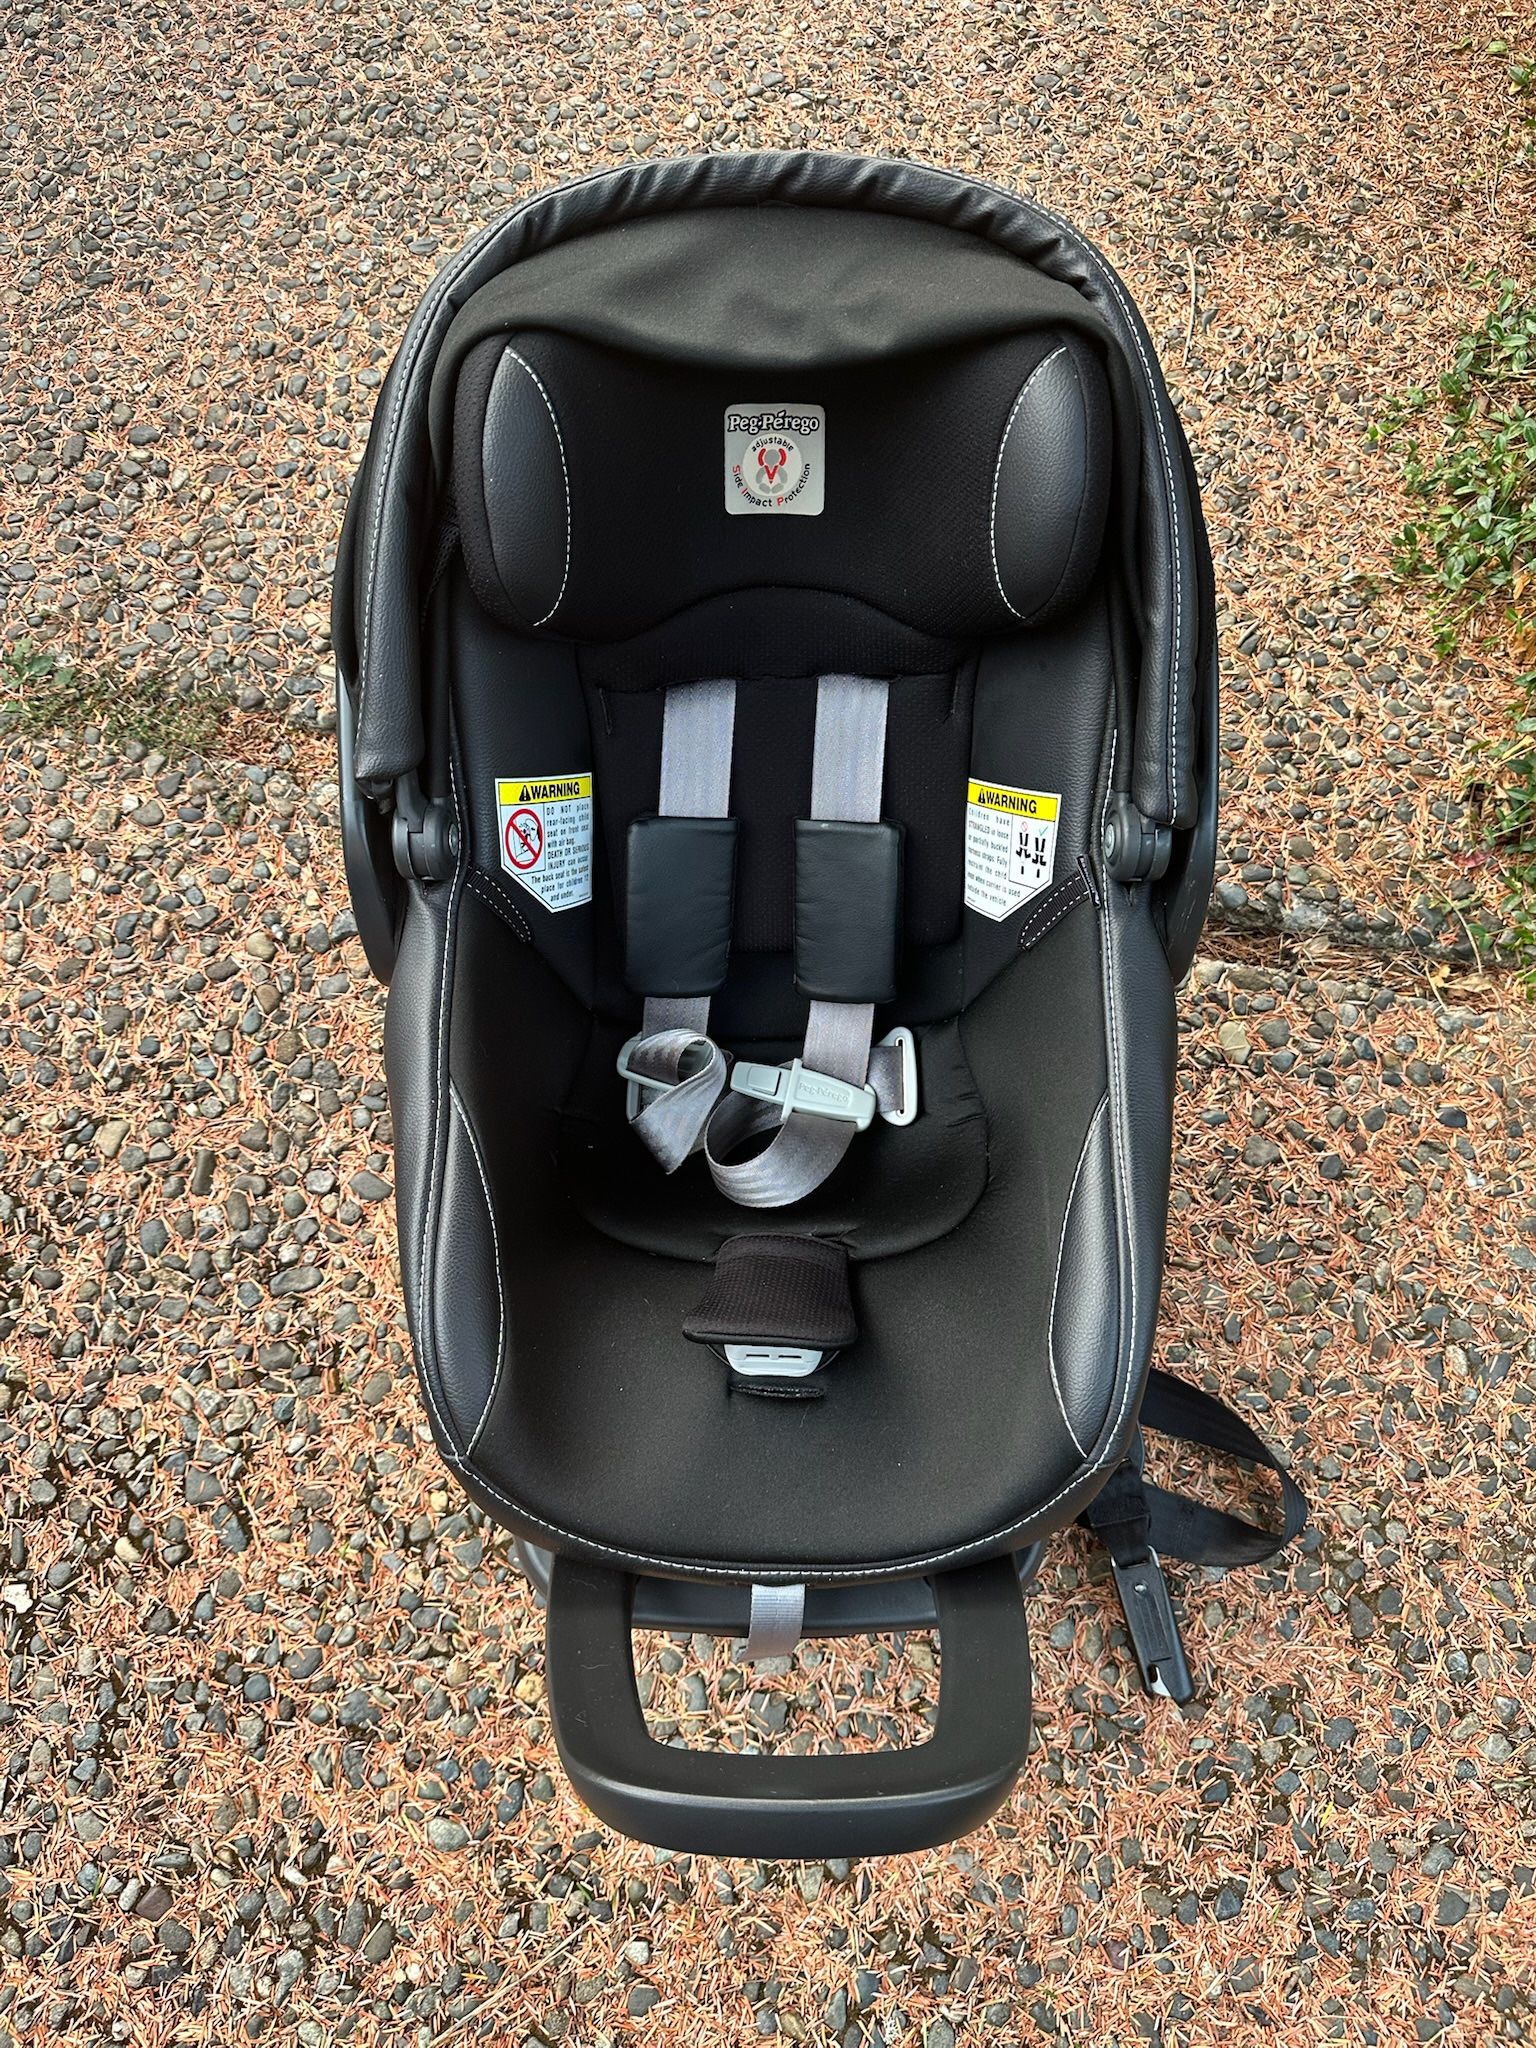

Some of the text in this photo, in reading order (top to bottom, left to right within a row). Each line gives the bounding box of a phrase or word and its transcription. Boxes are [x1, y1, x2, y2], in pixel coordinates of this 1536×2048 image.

[751, 436, 794, 453] adjustable
[732, 463, 811, 508] Side Impact Protection
[531, 782, 580, 799] WARNING
[986, 791, 1037, 814] WARNING
[546, 806, 555, 816] DO
[560, 804, 571, 813] NOT
[547, 828, 558, 838] seat
[547, 849, 563, 860] DEATH
[564, 847, 571, 856] OR
[547, 859, 565, 870] INJURY
[531, 875, 541, 885] The
[541, 884, 555, 895] place
